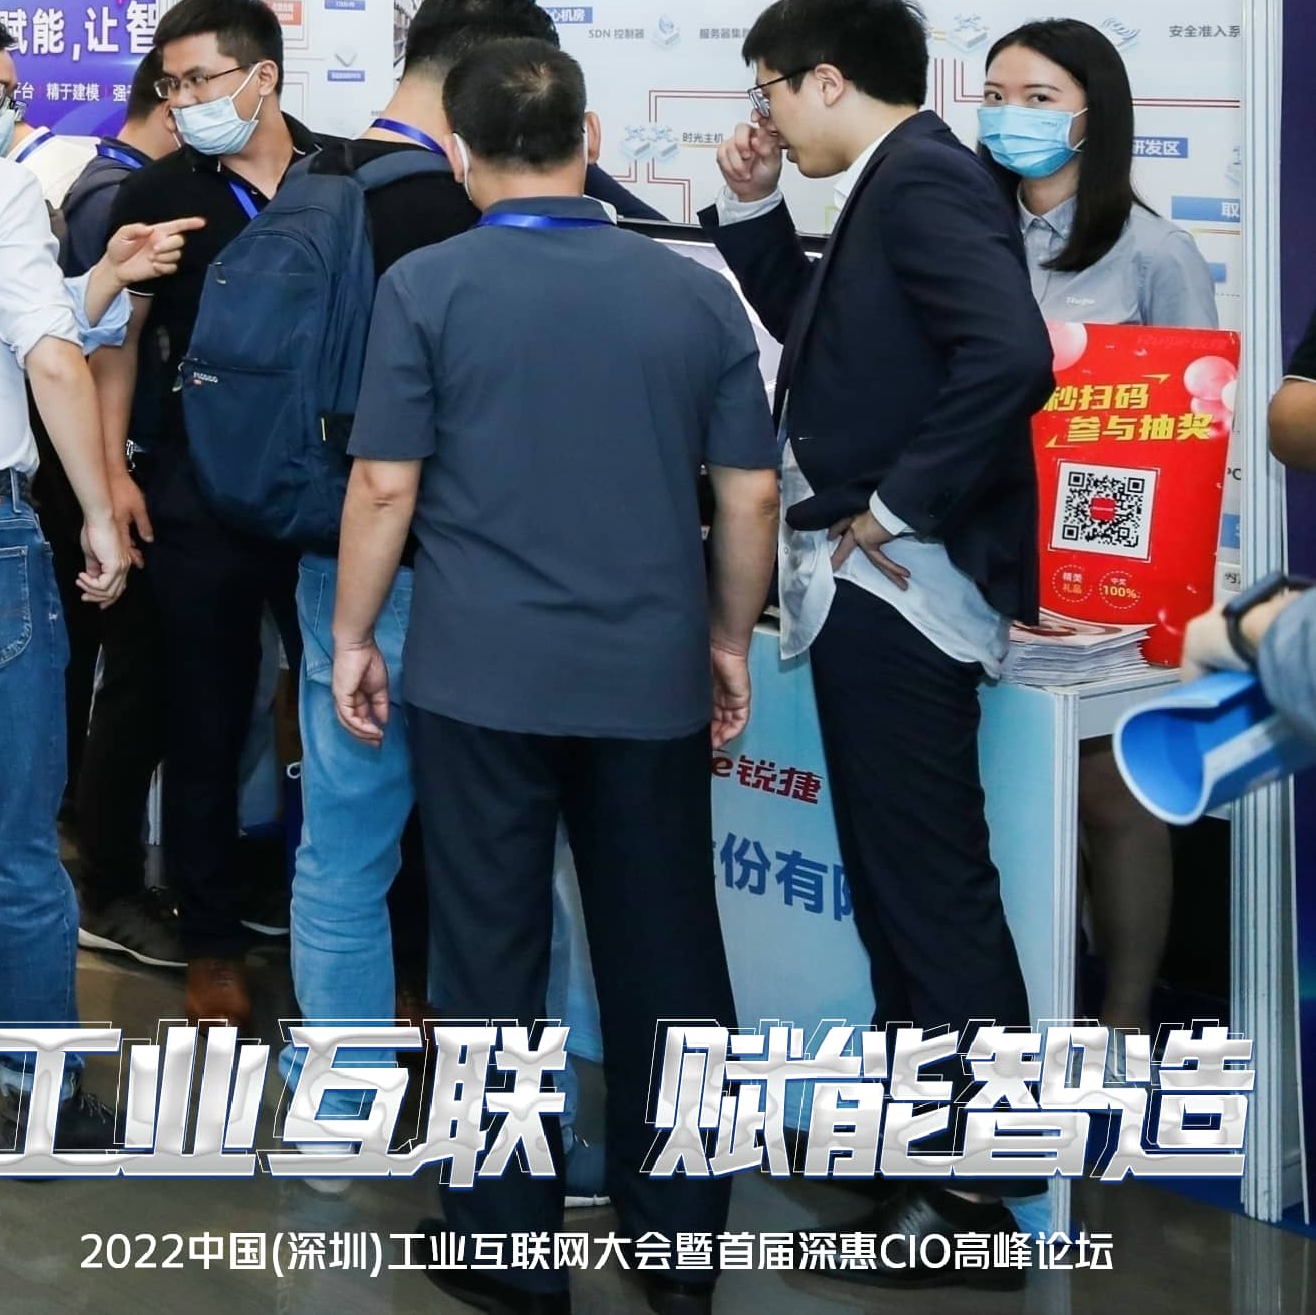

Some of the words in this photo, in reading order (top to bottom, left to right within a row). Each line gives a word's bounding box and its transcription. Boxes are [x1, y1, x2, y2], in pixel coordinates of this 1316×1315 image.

[588, 28, 612, 39] SDN
[614, 28, 645, 40] 控制器
[682, 132, 724, 144] 时光主机
[1067, 412, 1214, 443] 参与抽奖
